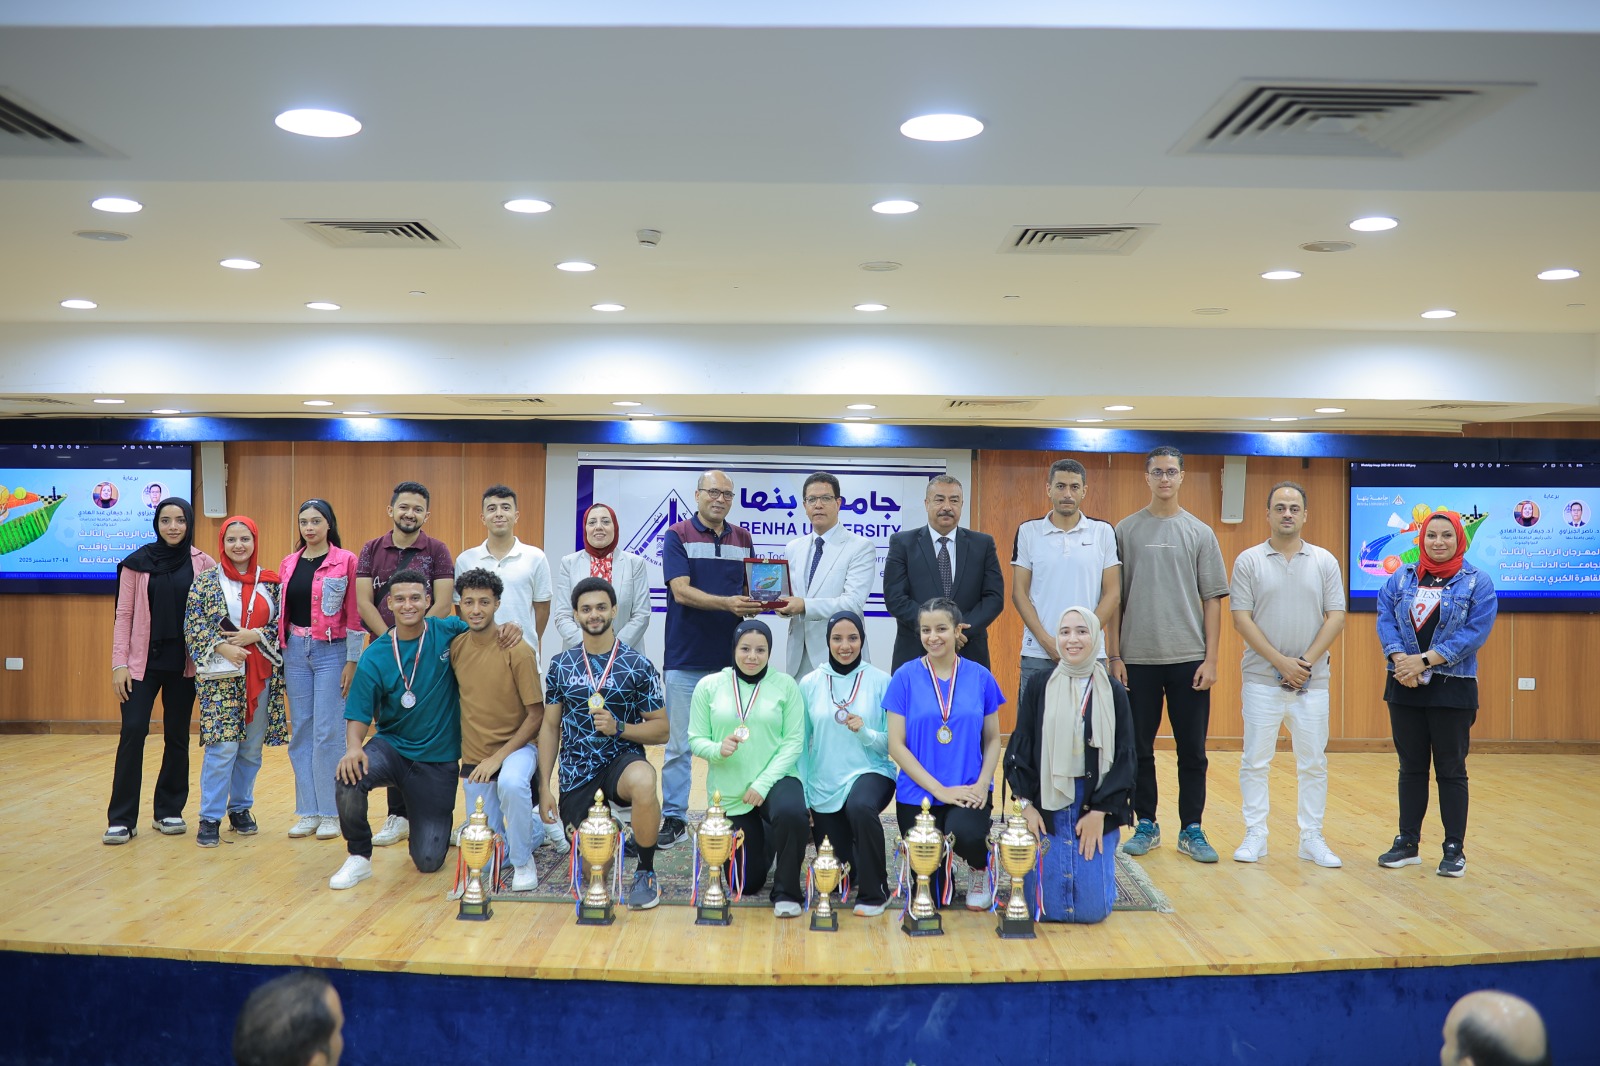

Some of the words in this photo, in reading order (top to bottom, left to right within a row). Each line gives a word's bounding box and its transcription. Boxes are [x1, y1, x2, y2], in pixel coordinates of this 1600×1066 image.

[740, 487, 798, 519] بنها
[78, 529, 104, 538] الثالث
[739, 521, 797, 536] BENHA
[803, 521, 901, 538] UERSITY
[105, 529, 140, 541] الرياضي
[1500, 546, 1526, 556] الثالث
[1526, 547, 1561, 559] الرياضي
[1562, 548, 1600, 558] لمهرجان
[79, 555, 95, 565] بنها
[1531, 560, 1558, 569] الدلتا
[1499, 560, 1531, 571] وإقليم
[1500, 574, 1517, 583] بنها
[1518, 574, 1546, 583] بجامعة
[1415, 589, 1441, 600] UESS
